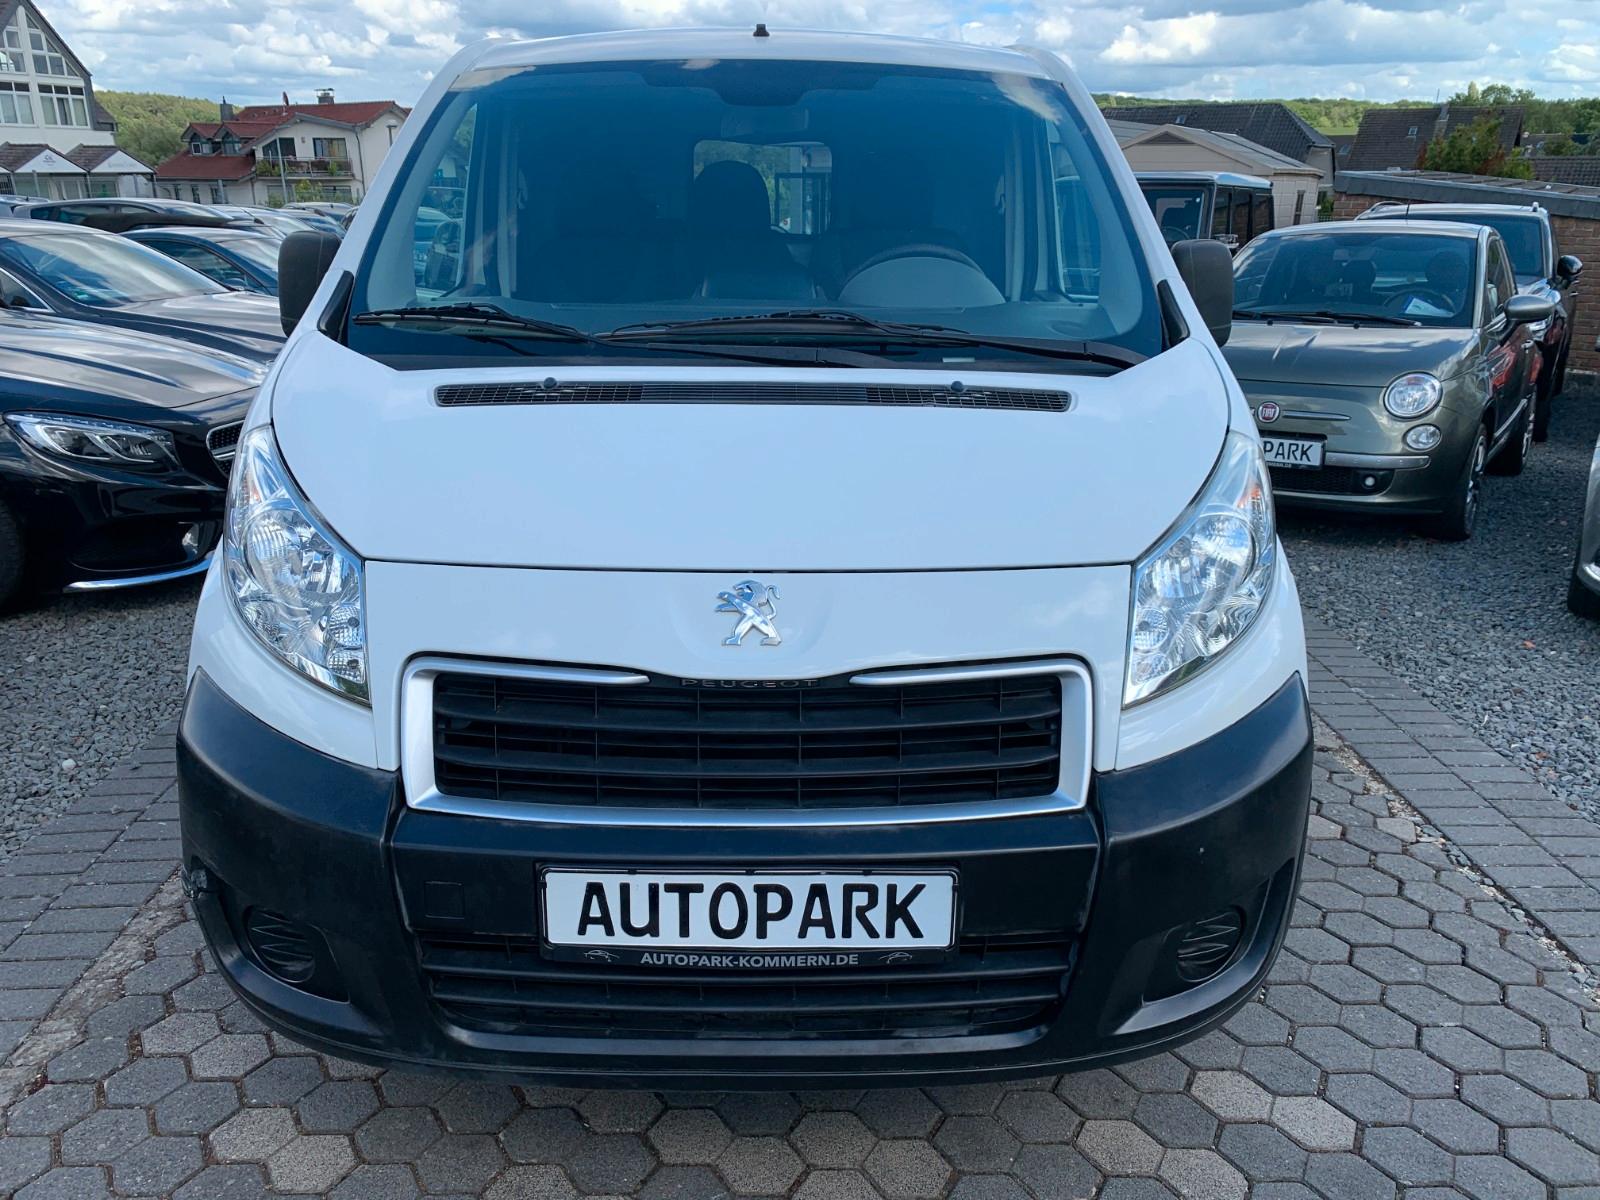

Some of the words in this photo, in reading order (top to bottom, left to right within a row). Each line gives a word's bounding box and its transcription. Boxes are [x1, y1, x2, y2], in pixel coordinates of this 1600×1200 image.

[1262, 408, 1275, 418] FIAT
[682, 679, 817, 689] PEUGEOT
[577, 882, 927, 940] AUTOPARK
[640, 952, 859, 968] AUTOPARK-KOMMERN.DE
